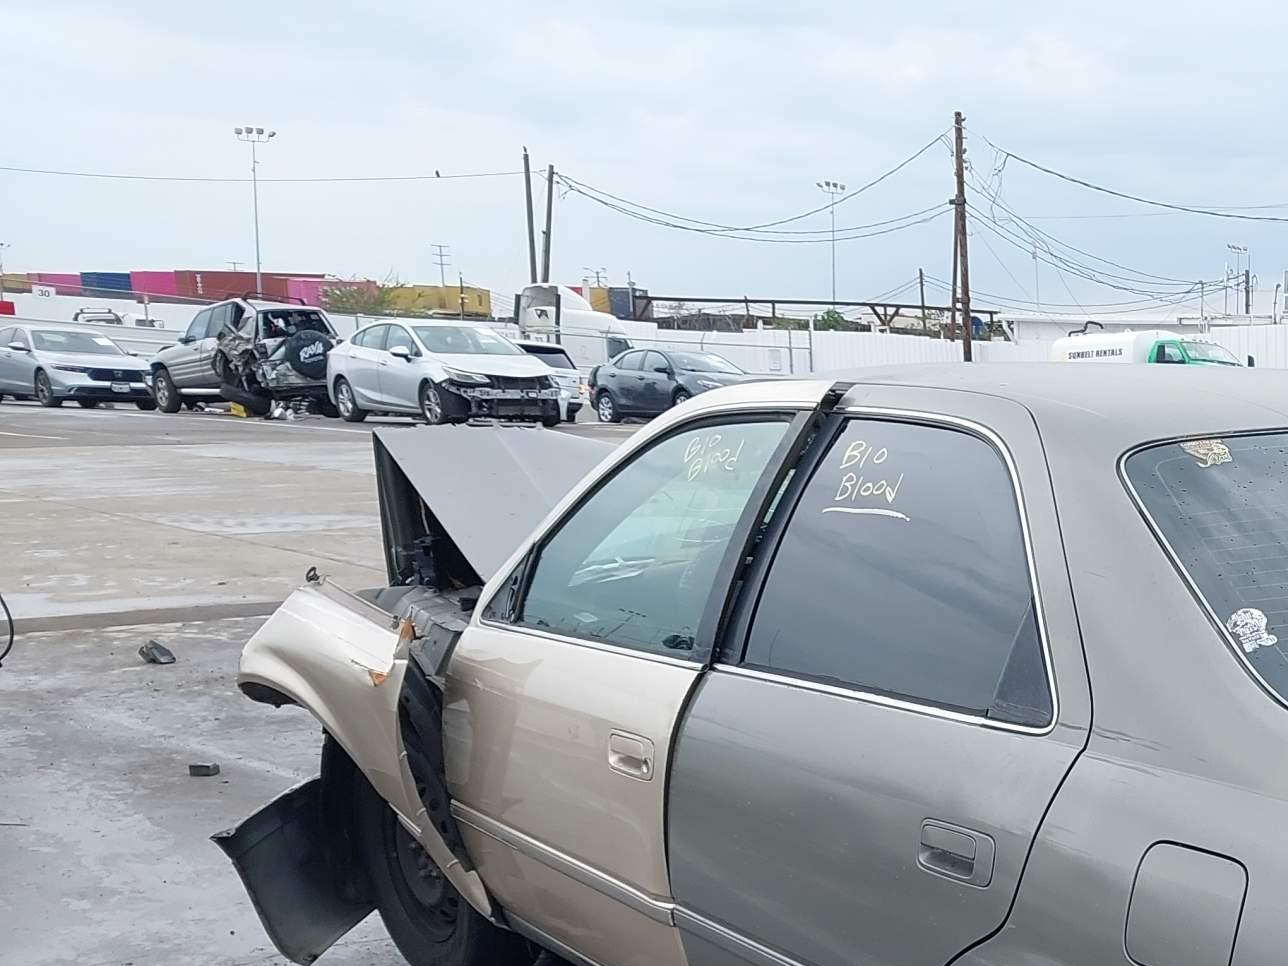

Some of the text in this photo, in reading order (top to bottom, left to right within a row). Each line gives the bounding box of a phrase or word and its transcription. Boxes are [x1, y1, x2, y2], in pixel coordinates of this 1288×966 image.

[38, 288, 50, 298] 30
[1067, 347, 1123, 360] SUNBELT RENTALS
